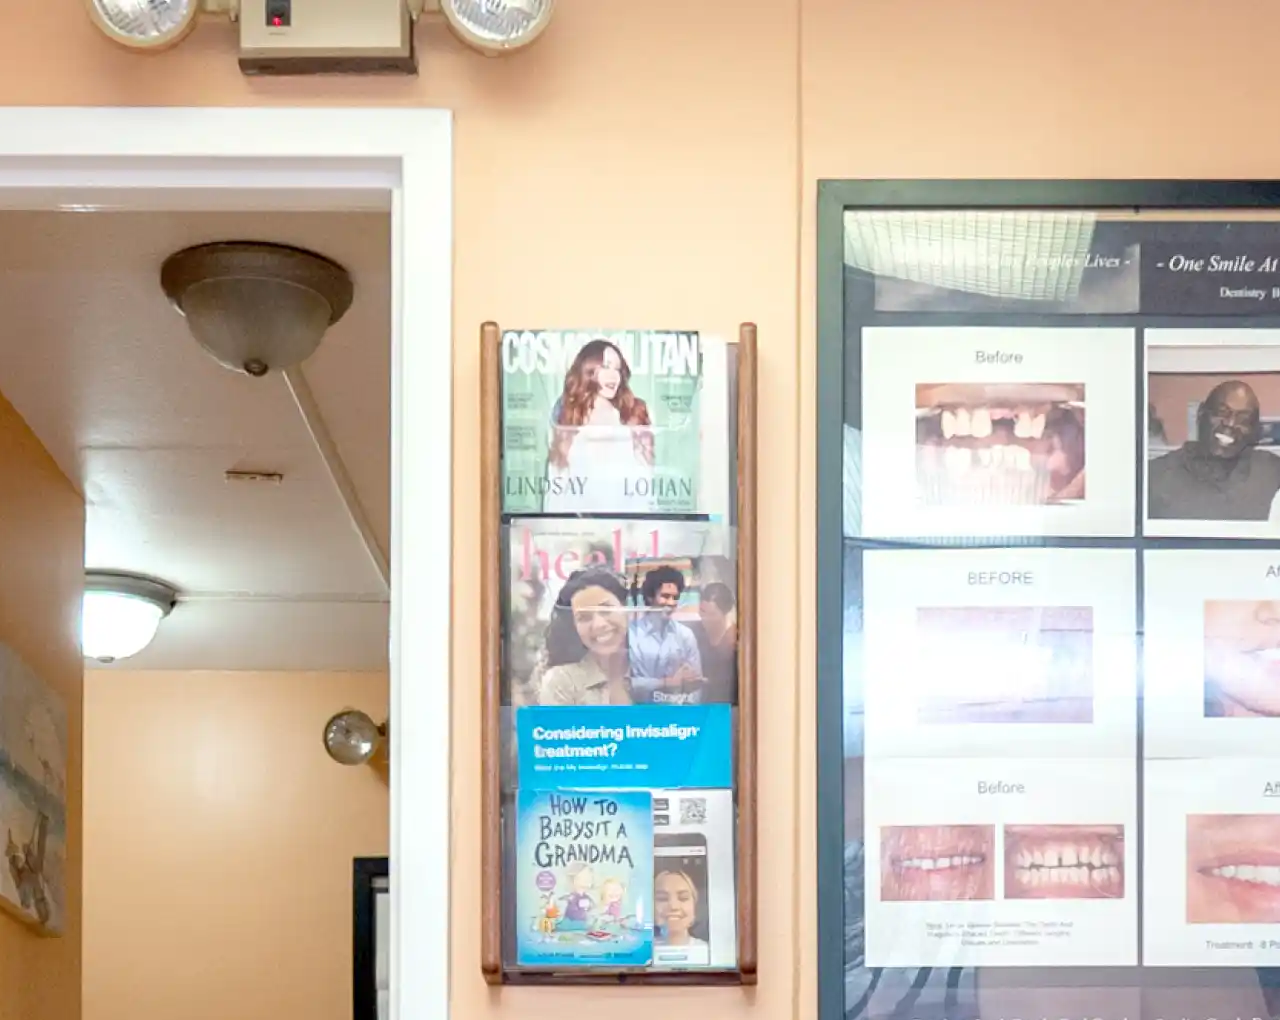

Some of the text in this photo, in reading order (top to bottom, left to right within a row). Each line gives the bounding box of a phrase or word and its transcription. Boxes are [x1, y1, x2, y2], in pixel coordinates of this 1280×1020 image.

[1084, 253, 1122, 269] Lives
[1168, 254, 1204, 272] One
[1207, 254, 1255, 273] Smile
[1258, 255, 1279, 273] At
[1220, 286, 1267, 300] Dentistry
[975, 350, 1024, 364] Before
[506, 476, 693, 496] LINDSAY LOHAN
[967, 571, 1035, 586] BEFORE
[532, 726, 624, 742] Considering
[533, 743, 618, 758] treatment?
[977, 780, 1026, 795] Before
[549, 793, 618, 816] HOW TO
[539, 815, 628, 841] BABYSIT A
[534, 841, 635, 869] GRANDMA
